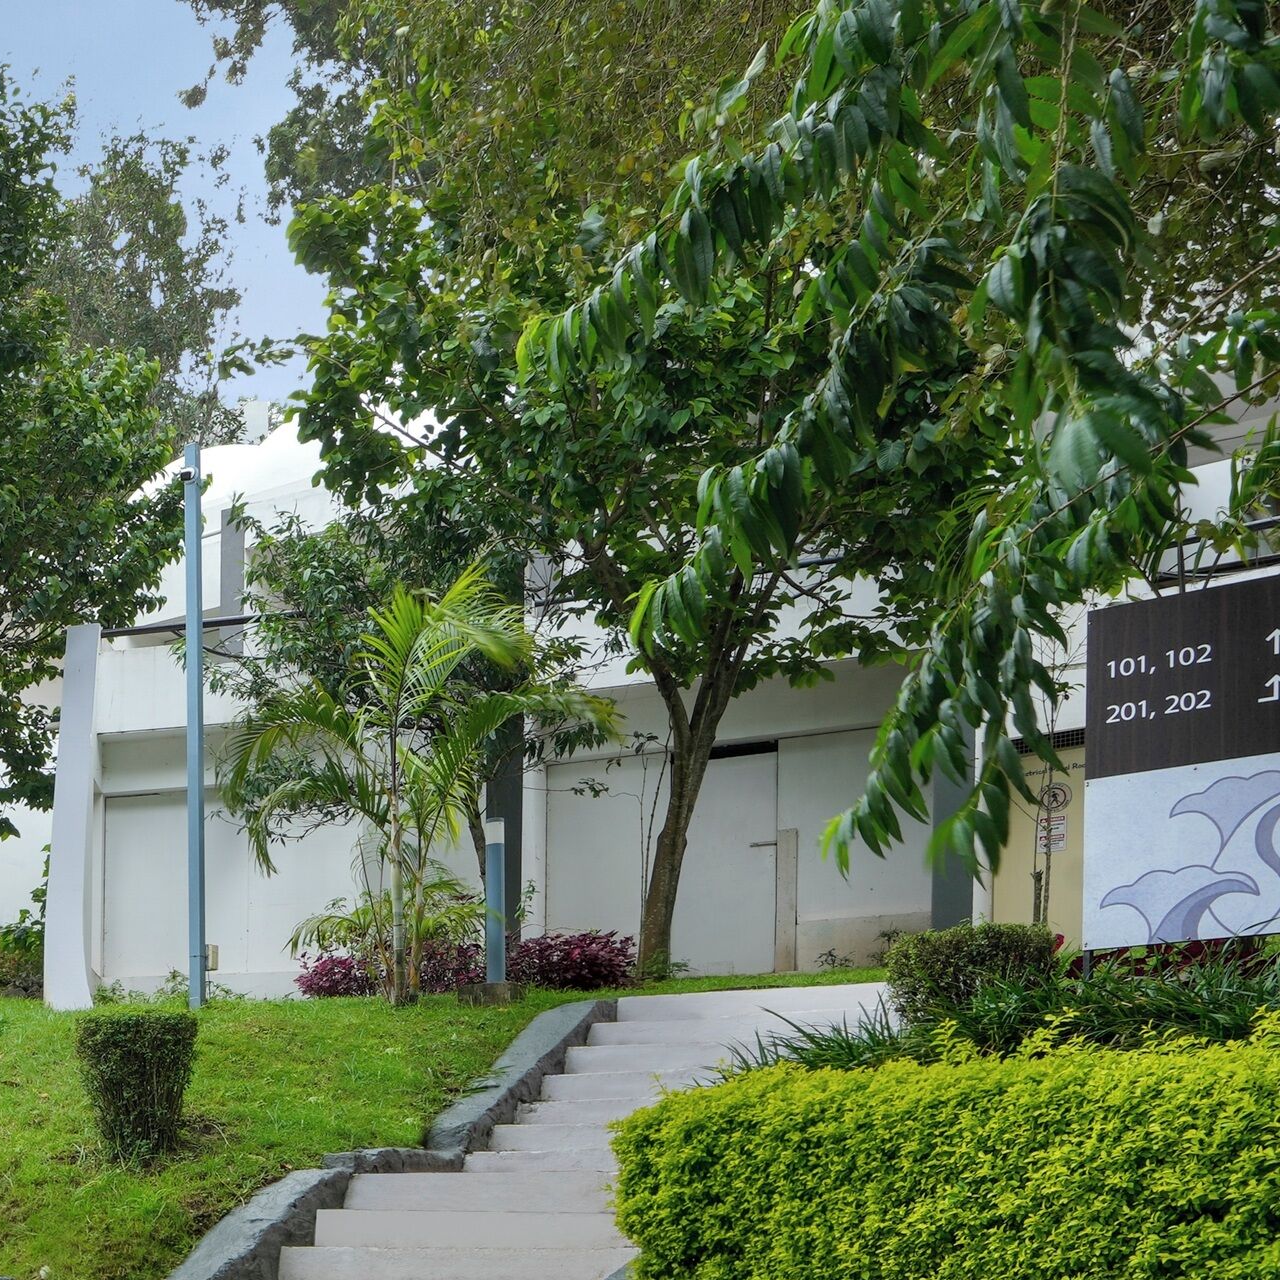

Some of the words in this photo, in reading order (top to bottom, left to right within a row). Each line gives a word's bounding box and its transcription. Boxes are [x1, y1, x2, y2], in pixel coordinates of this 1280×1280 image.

[1106, 655, 1156, 679] 101,
[1165, 643, 1212, 668] 102
[1105, 699, 1156, 724] 201,
[1164, 689, 1212, 715] 202
